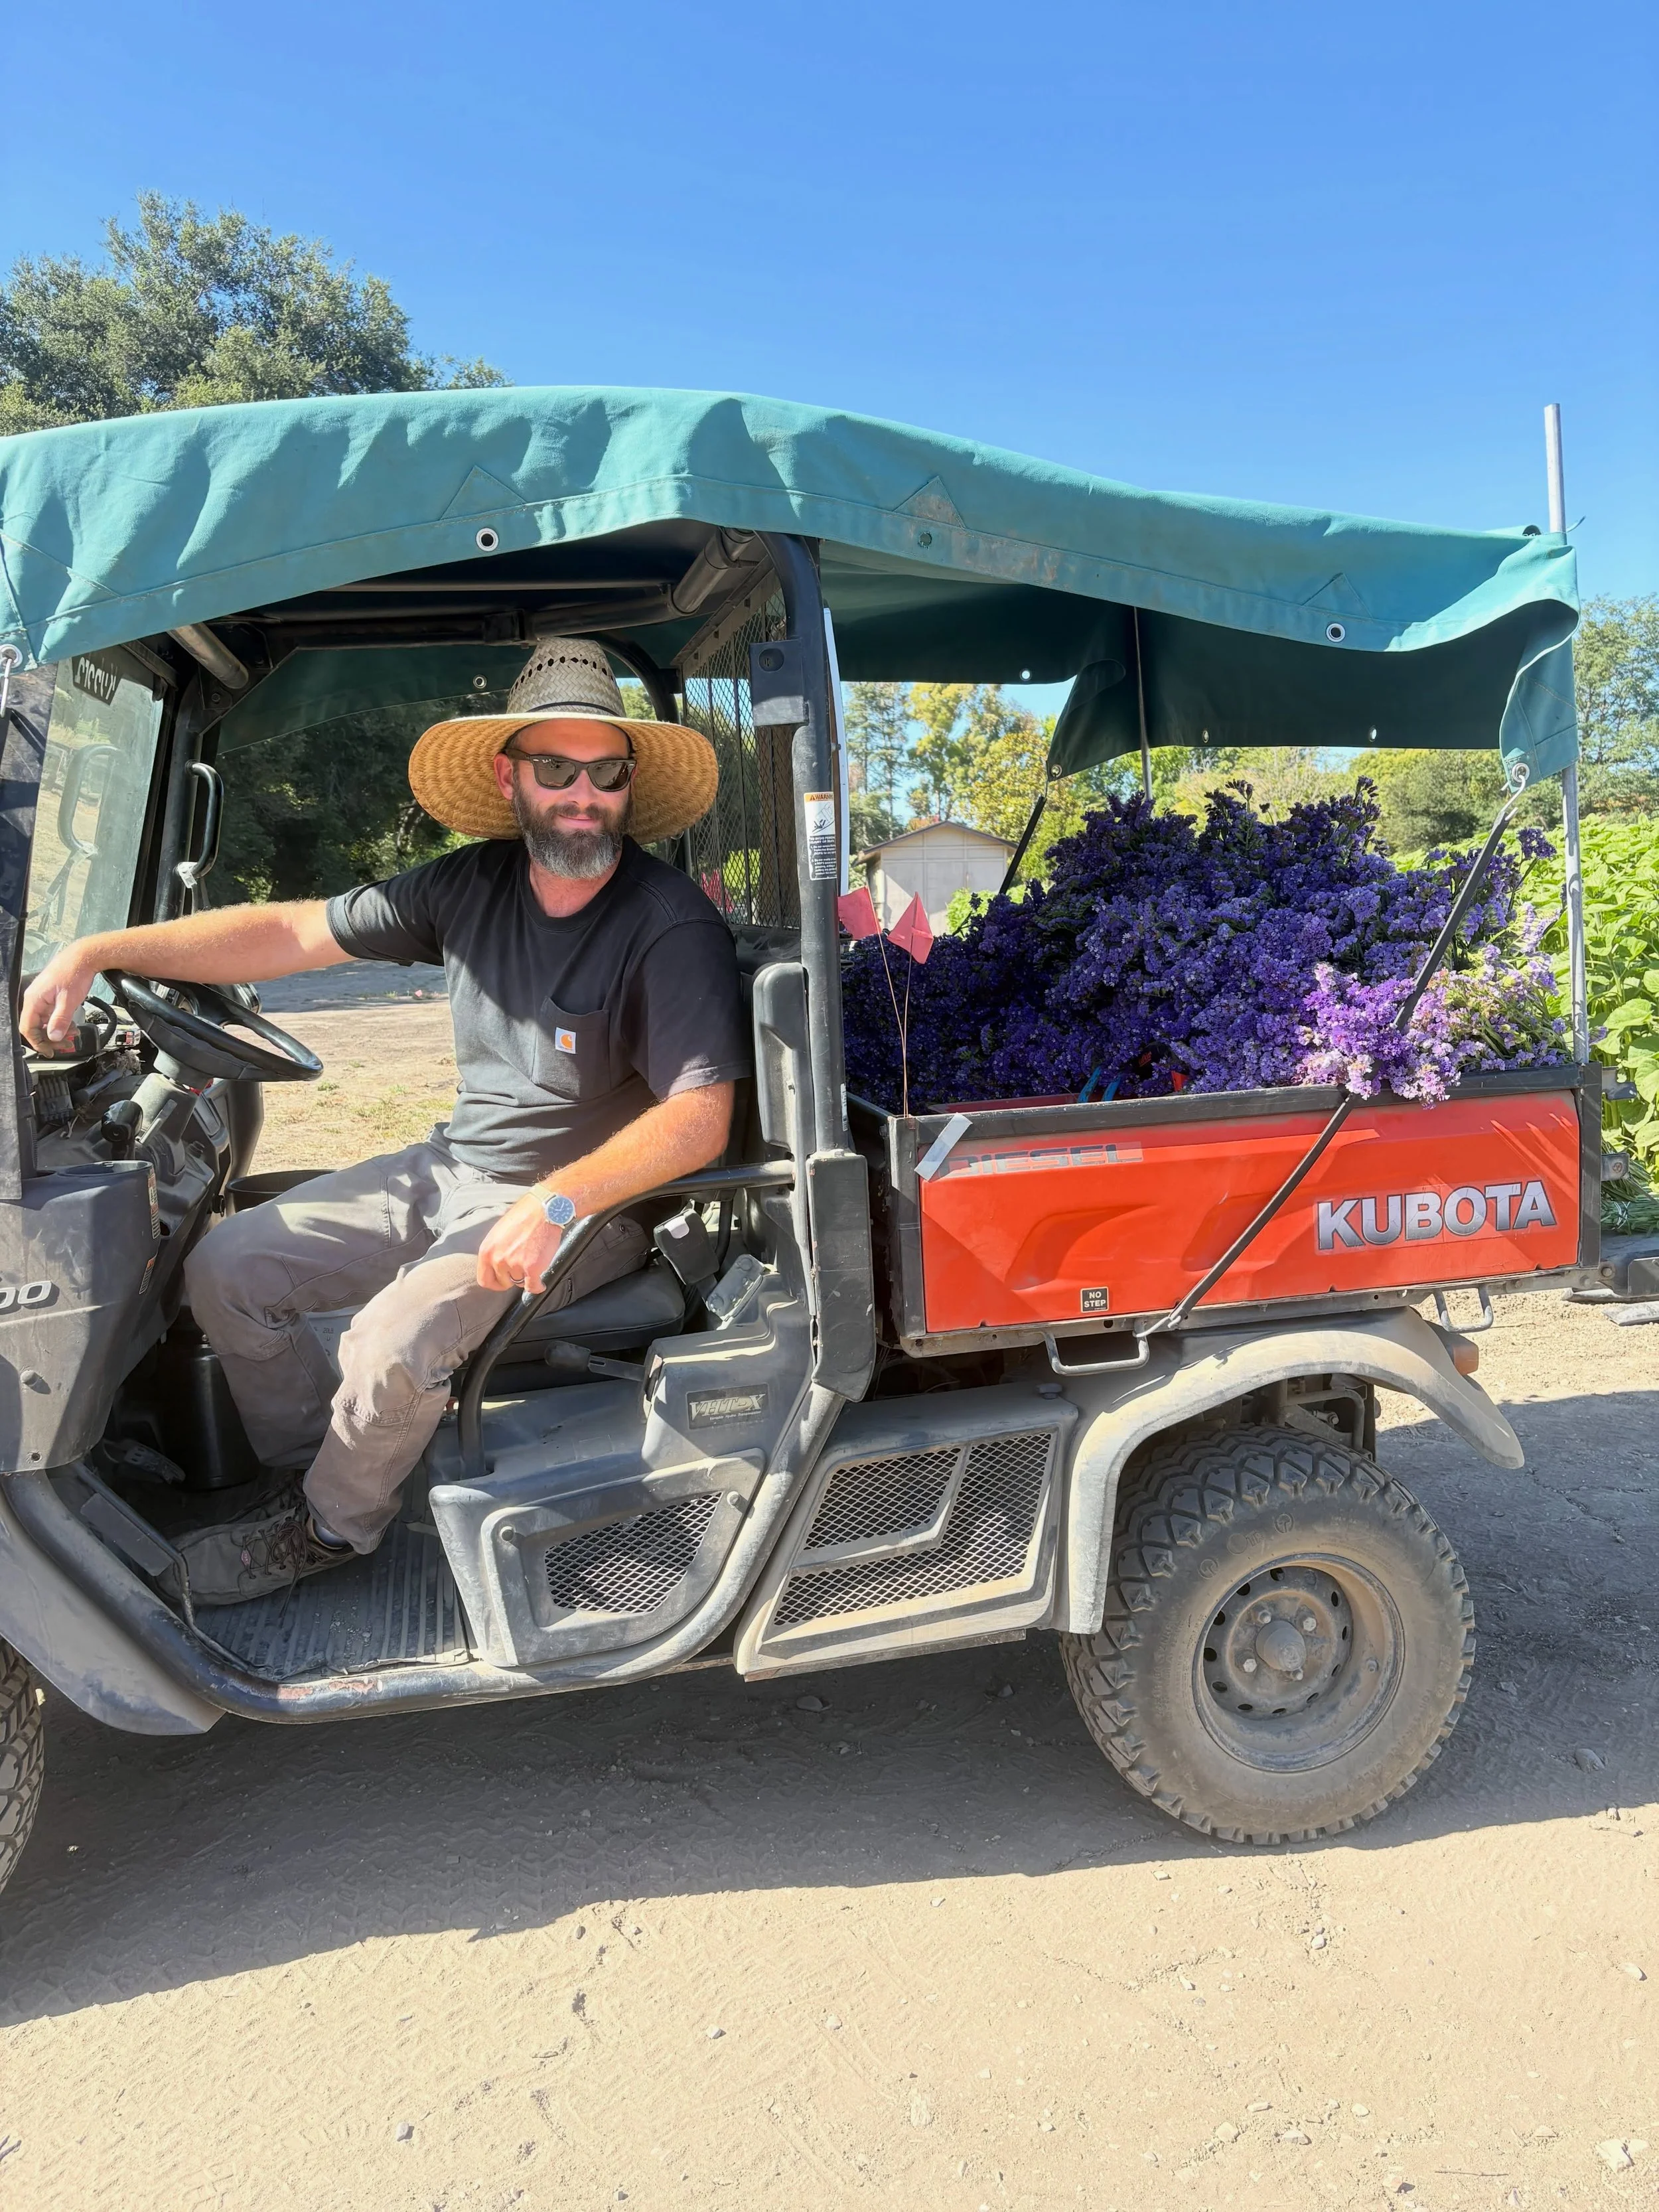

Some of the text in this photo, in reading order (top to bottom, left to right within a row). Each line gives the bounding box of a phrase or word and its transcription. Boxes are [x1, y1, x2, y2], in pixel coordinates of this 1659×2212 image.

[940, 1143, 1142, 1177] DIESEL
[1318, 1180, 1557, 1250] KUBOTA
[1084, 1299, 1106, 1308] STEP
